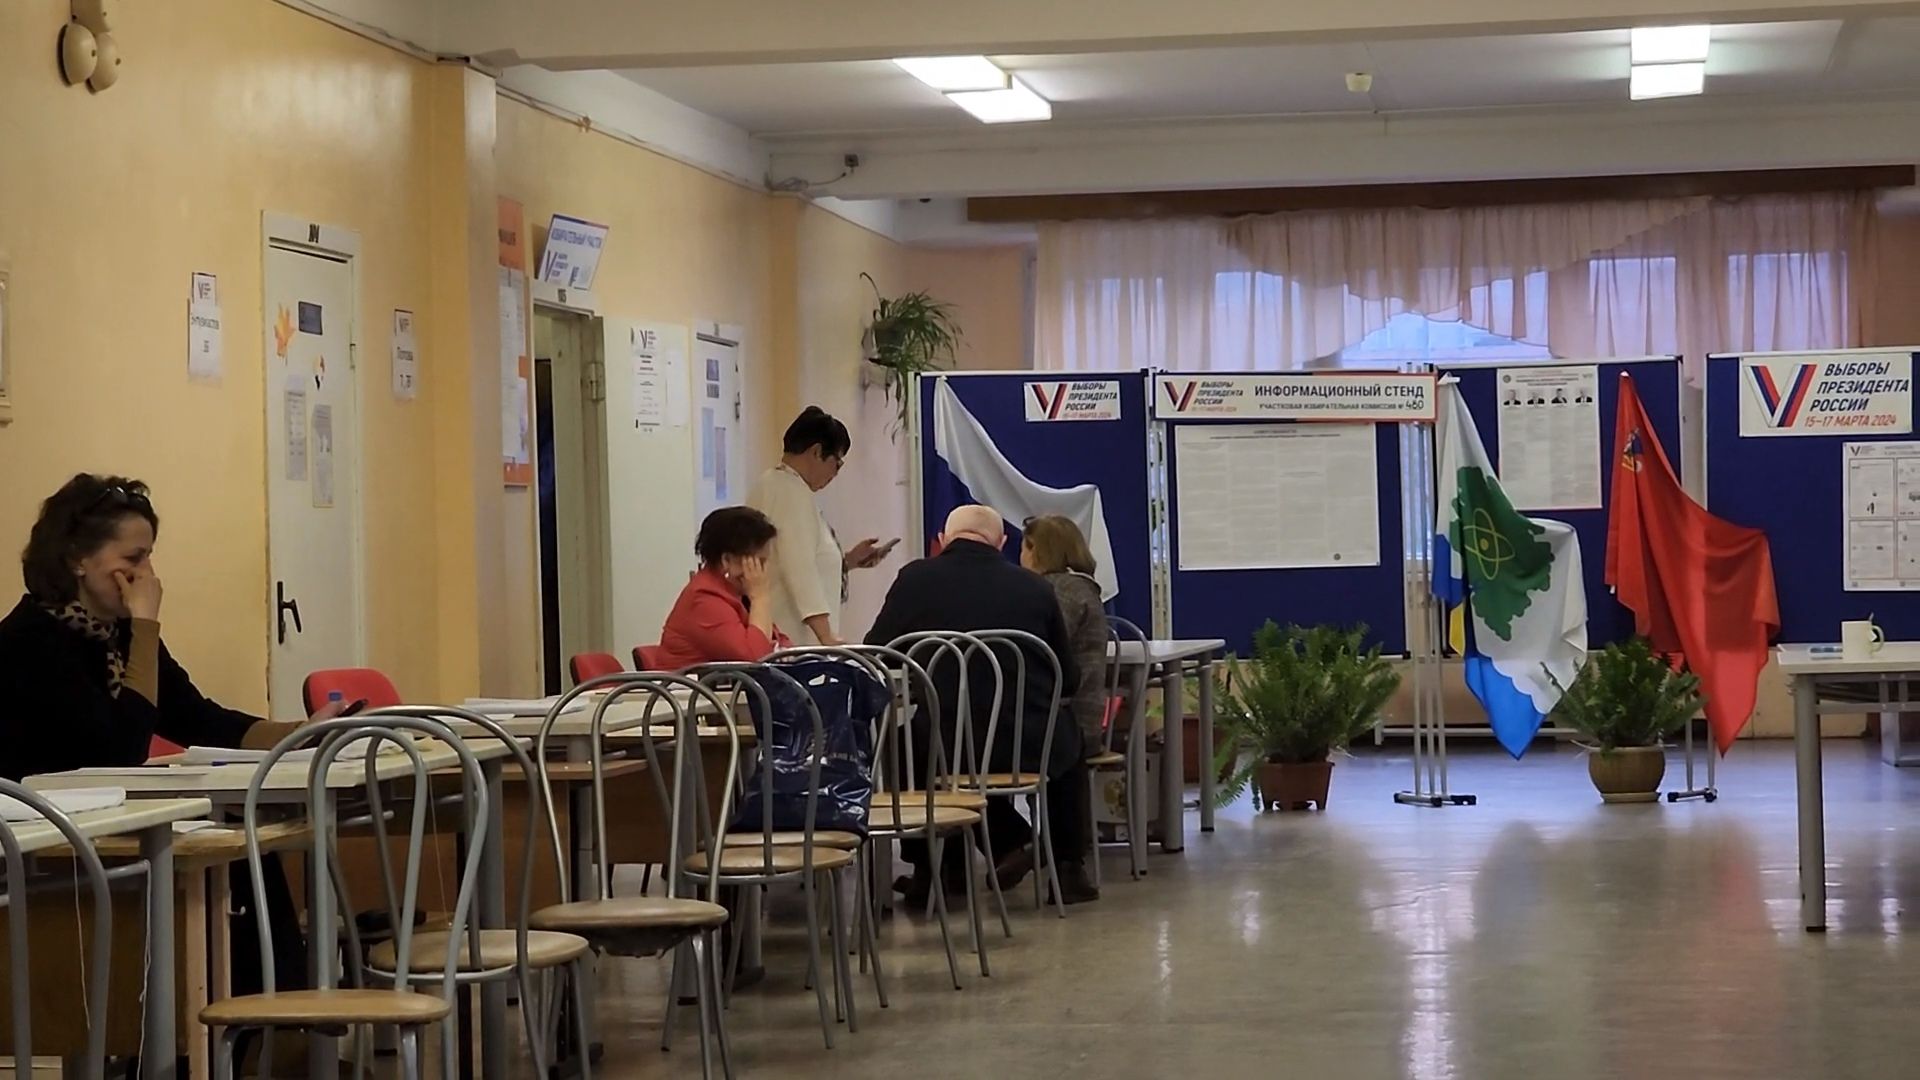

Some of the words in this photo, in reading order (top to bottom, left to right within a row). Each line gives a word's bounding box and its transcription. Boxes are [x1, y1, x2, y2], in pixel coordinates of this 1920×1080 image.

[1824, 362, 1891, 377] ВЫБОРЫ
[1071, 383, 1107, 391] ВЫБОРЫ
[1197, 389, 1244, 397] ПРЕЗИДЕНТА
[1255, 384, 1381, 398] ИНФОРМАЦИОННЫЙ
[1385, 385, 1424, 398] СТЕНД
[1817, 379, 1909, 395] ПРЕЗИДЕНТА
[1068, 392, 1118, 400] ПРЕЗИДЕНТА
[1065, 403, 1097, 411] РОССИИ
[1809, 398, 1870, 412] РОССИИ
[1835, 415, 1869, 427] МАРТА
[1871, 414, 1898, 427] 2024
